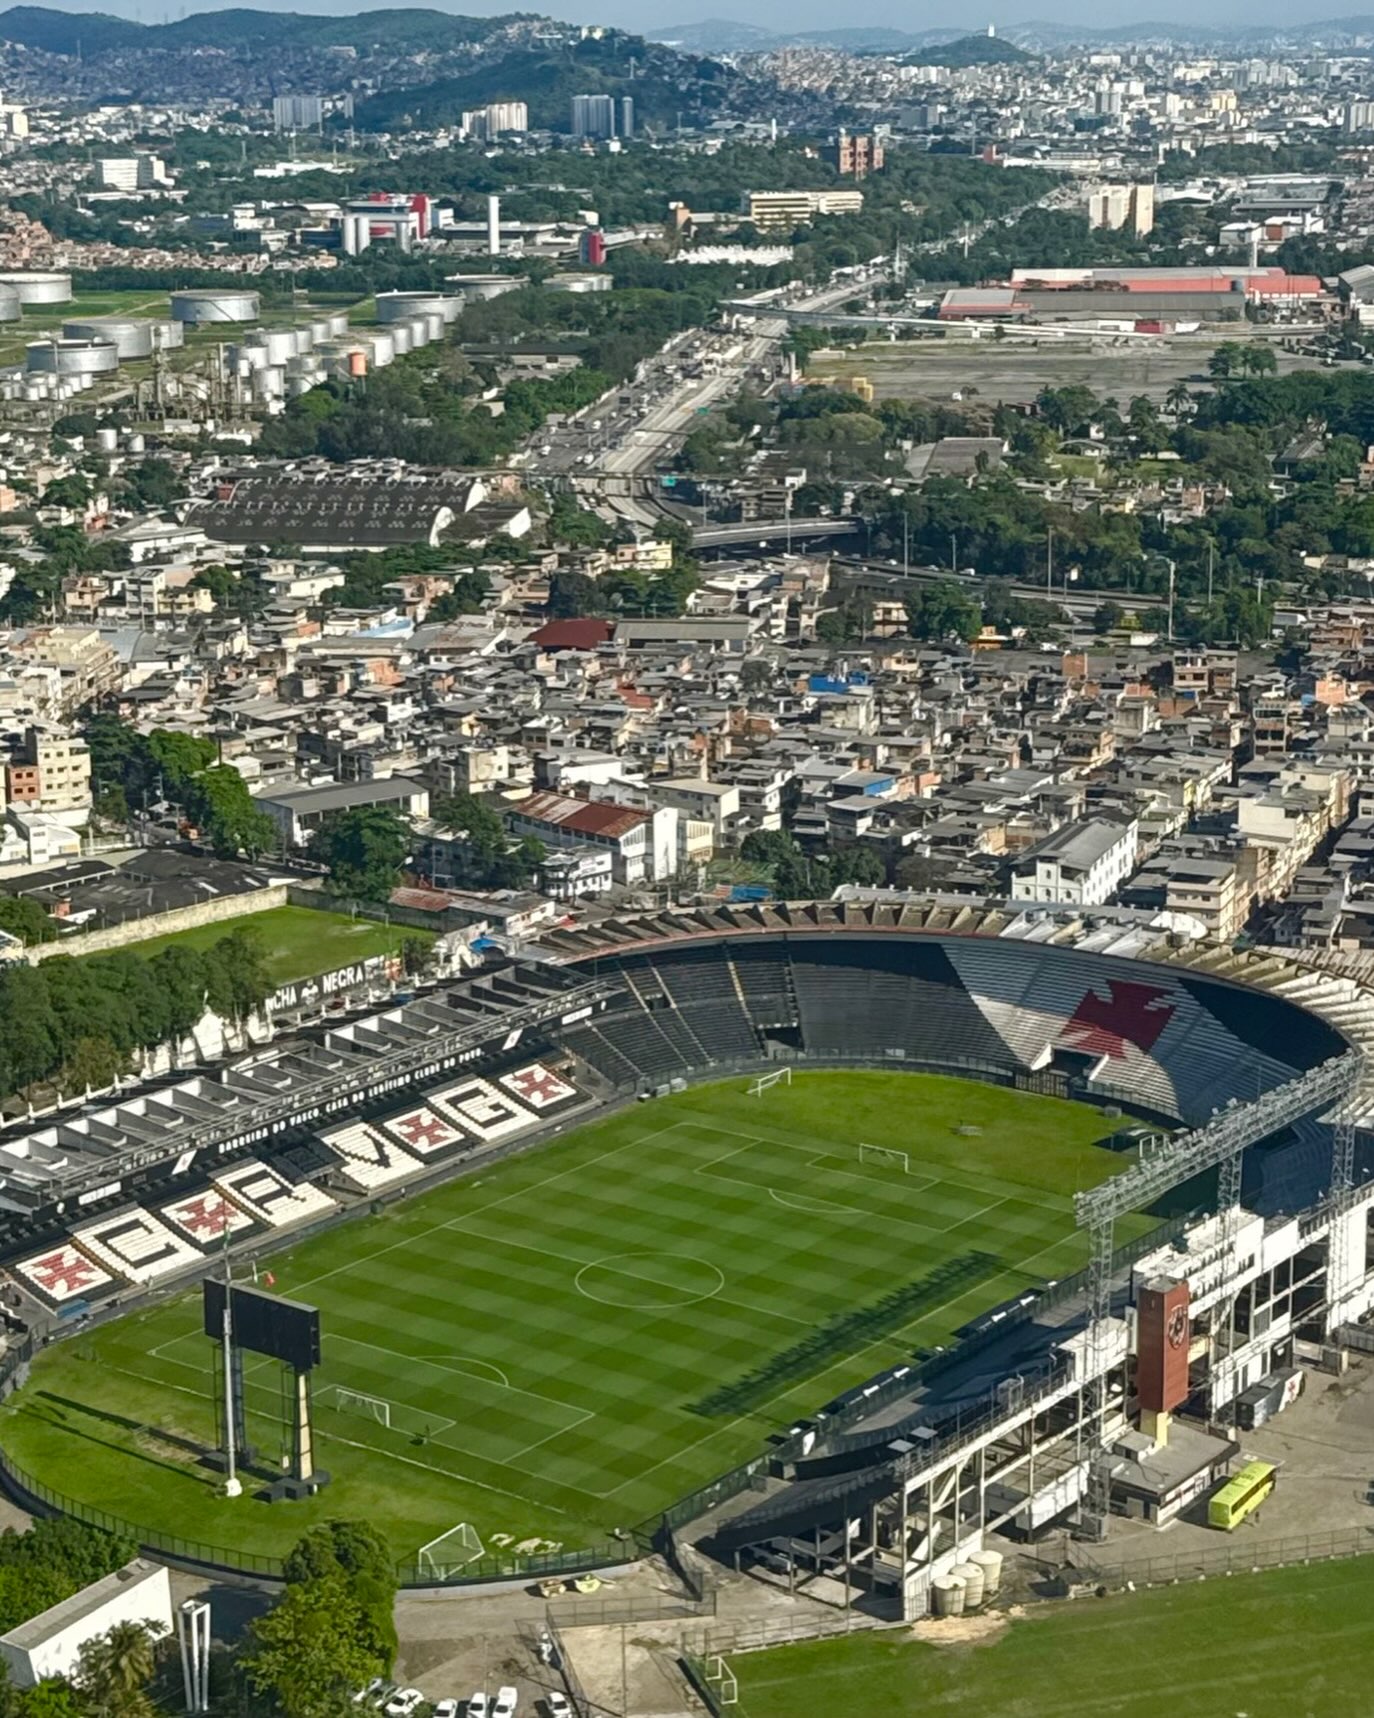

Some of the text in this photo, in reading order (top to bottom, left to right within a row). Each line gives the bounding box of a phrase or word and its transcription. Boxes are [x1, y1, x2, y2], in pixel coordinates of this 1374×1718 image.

[265, 966, 363, 1010] NCHA NEGRA
[219, 1127, 269, 1154] BARREIRA
[272, 1120, 286, 1134] DO
[325, 1096, 349, 1113] CASA
[352, 1091, 365, 1103] DO
[443, 1057, 456, 1069] DO
[94, 1086, 518, 1269] C R V G
